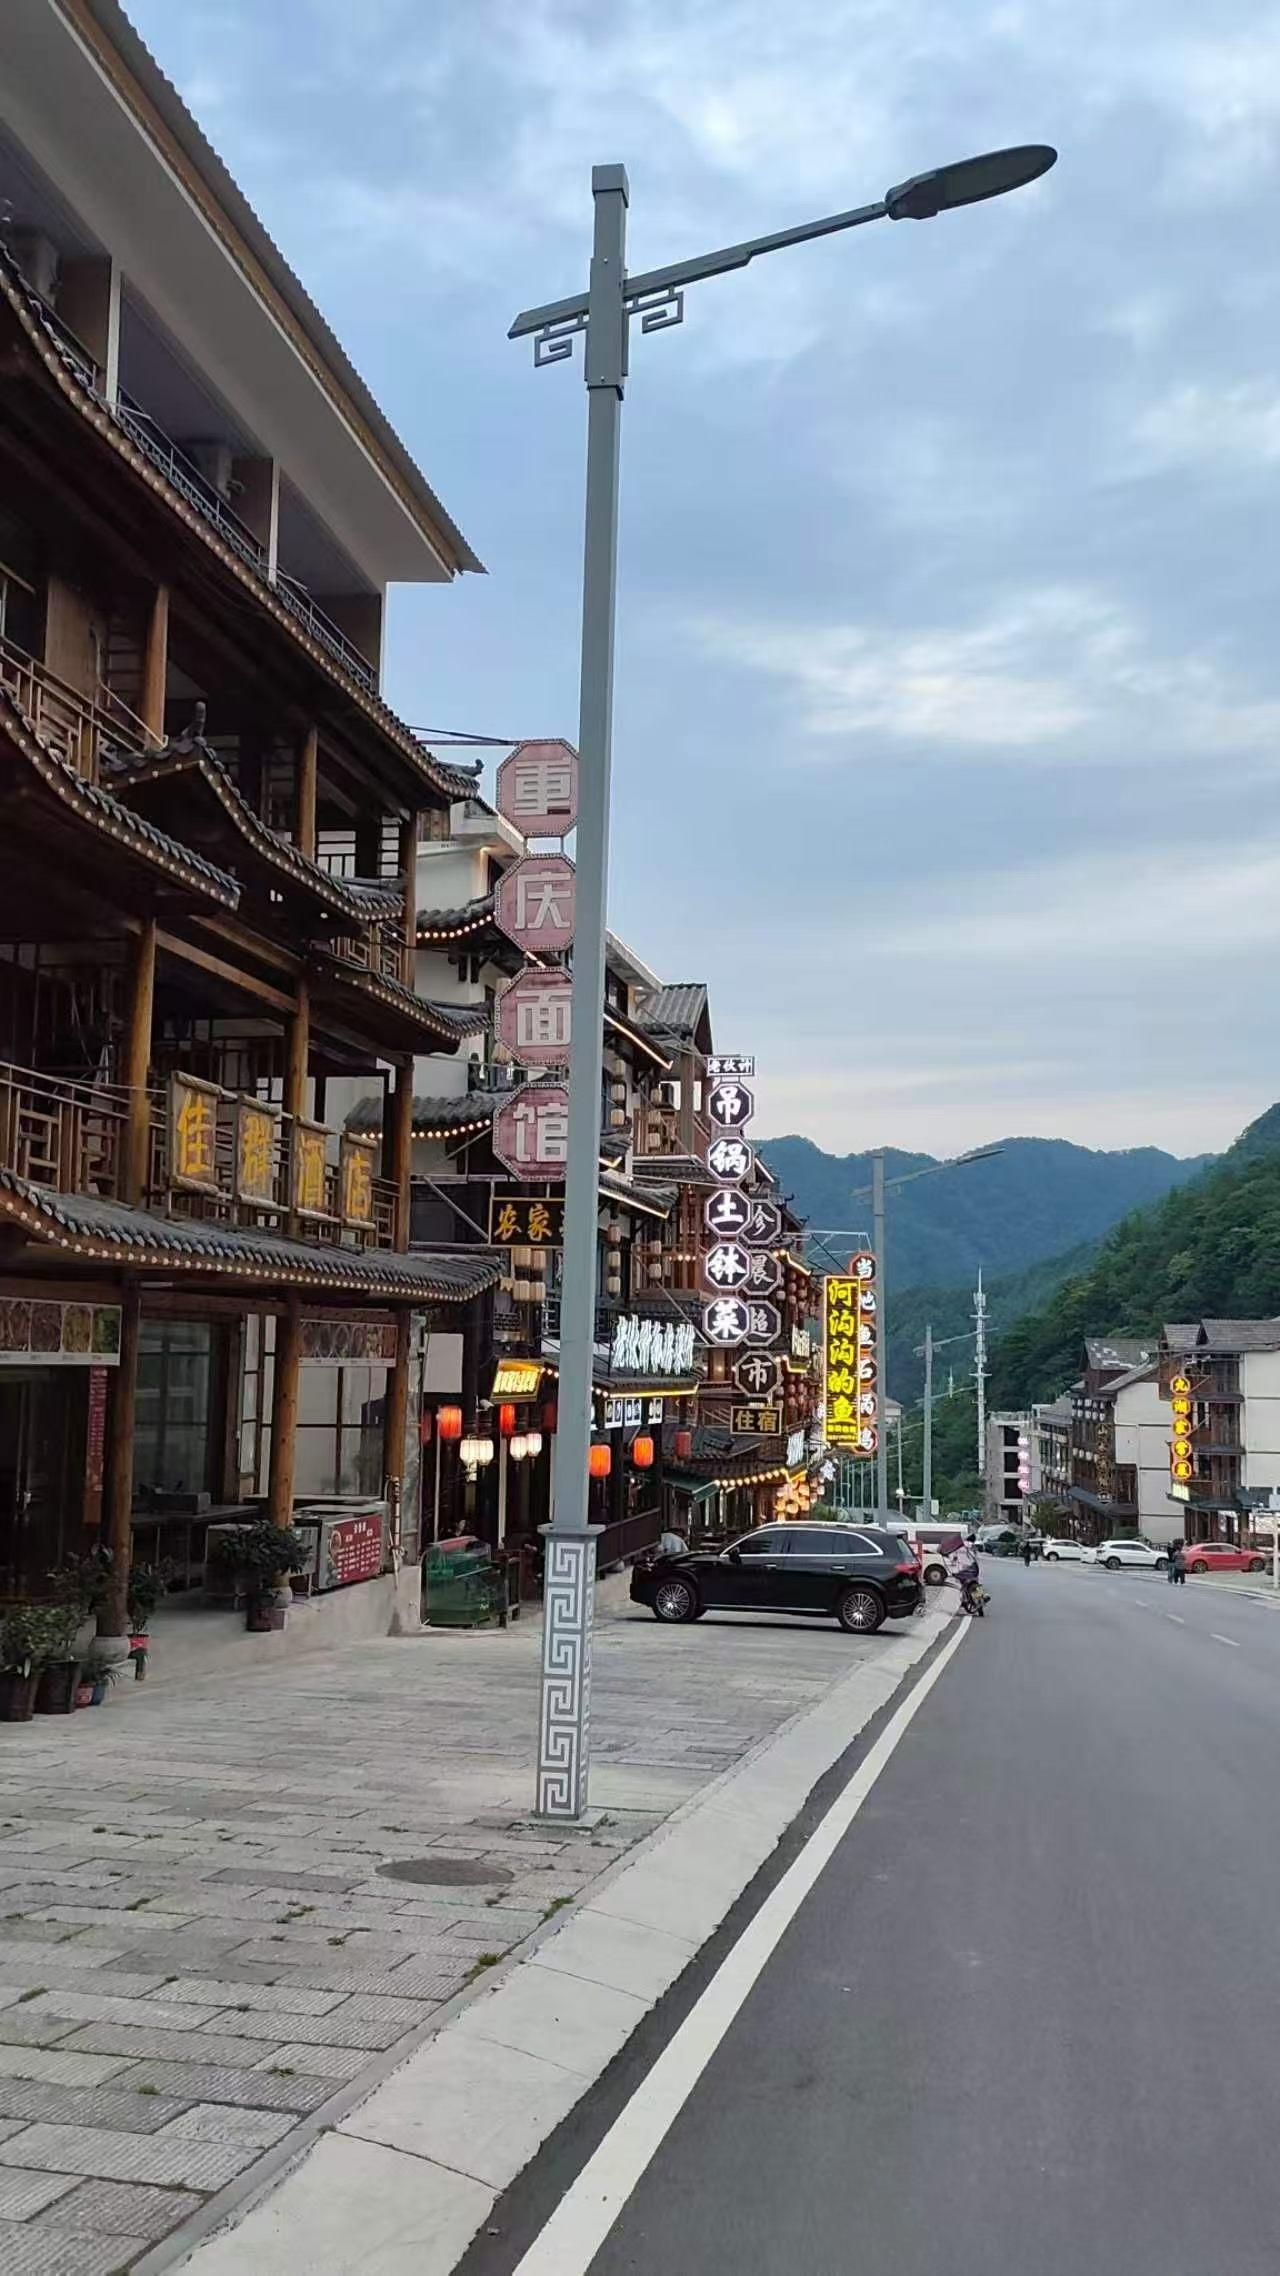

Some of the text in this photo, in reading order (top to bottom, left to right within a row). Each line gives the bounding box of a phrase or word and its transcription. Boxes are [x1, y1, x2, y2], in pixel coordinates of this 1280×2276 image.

[513, 756, 573, 1163] 重庆面馆
[708, 1057, 752, 1073] 老伙计
[494, 1203, 566, 1241] 农家
[708, 1086, 747, 1339] 吊锅土钵菜
[735, 1410, 777, 1432] 住宿
